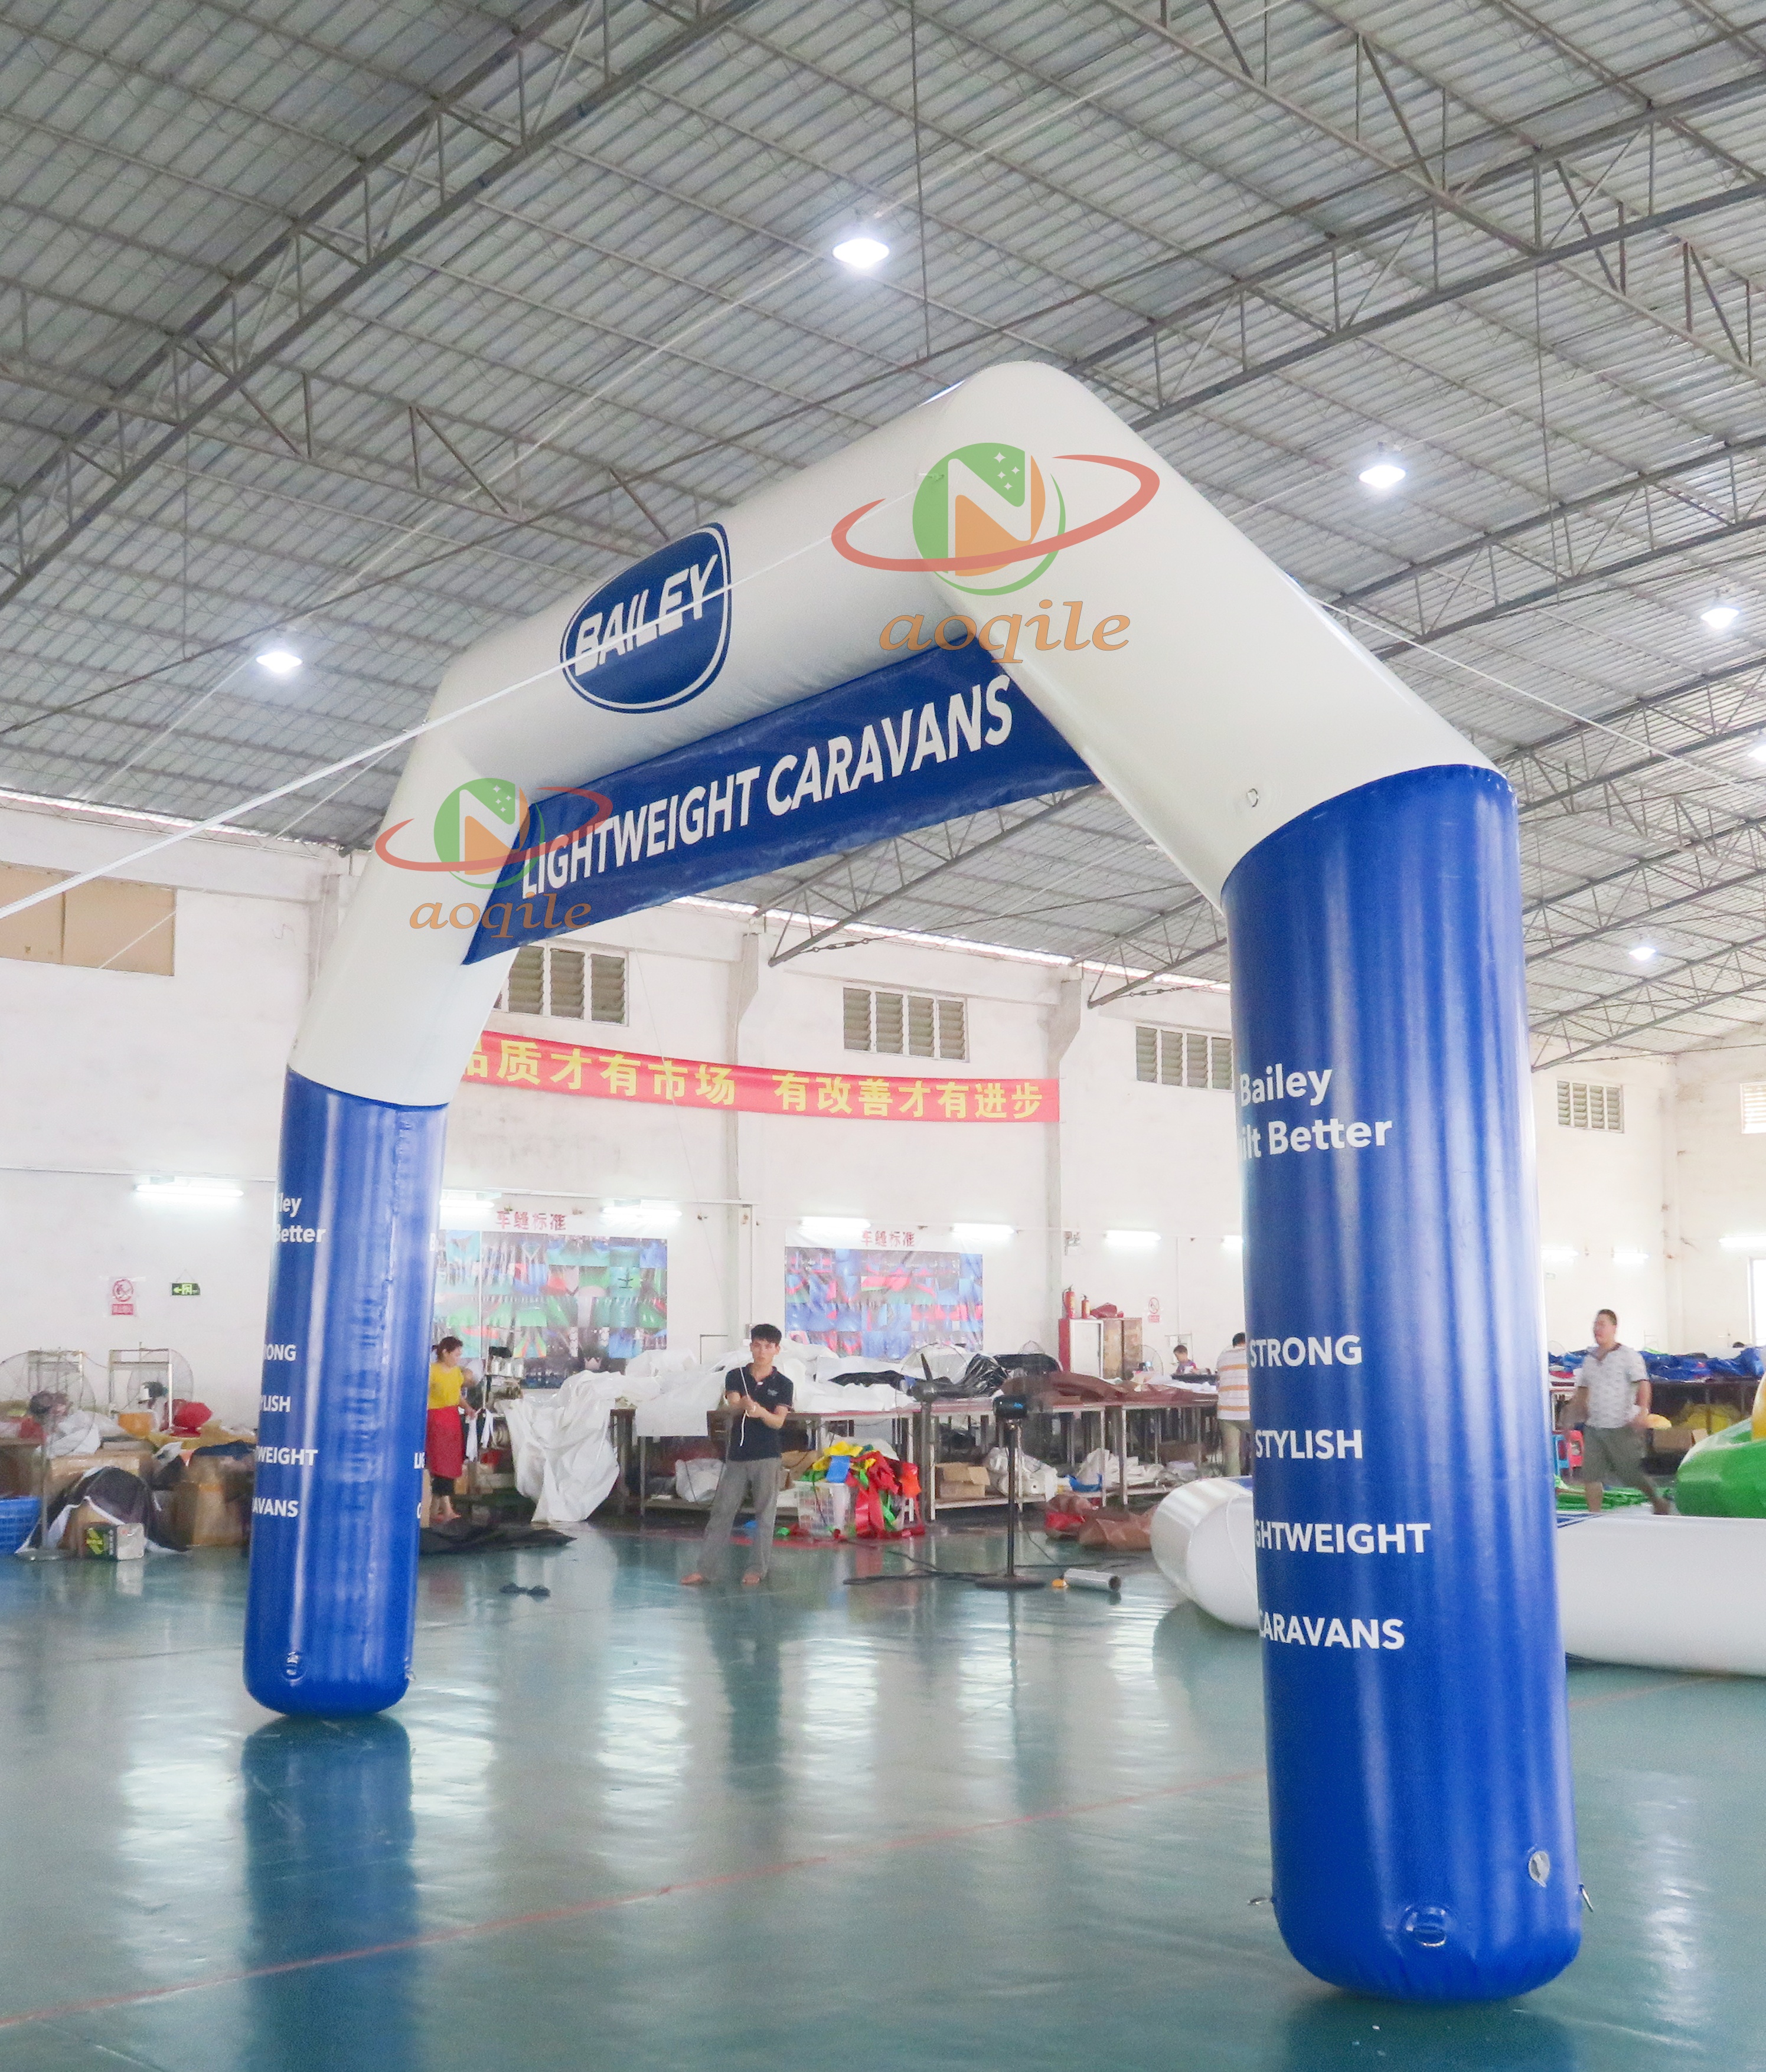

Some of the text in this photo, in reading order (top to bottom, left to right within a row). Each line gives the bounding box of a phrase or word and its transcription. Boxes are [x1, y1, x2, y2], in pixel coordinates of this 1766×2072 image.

[574, 554, 719, 676] BAILEY
[522, 674, 1013, 900] LIGHTWEIGHT CARAVANS
[772, 1072, 1043, 1119] 有改善才有进步
[1240, 1063, 1333, 1107] Bailey
[1268, 1117, 1393, 1156] Better
[1249, 1334, 1363, 1368] STRONG
[254, 1446, 319, 1466] WEIGHT
[1255, 1429, 1363, 1460] STYLISH
[252, 1497, 299, 1518] AVANS
